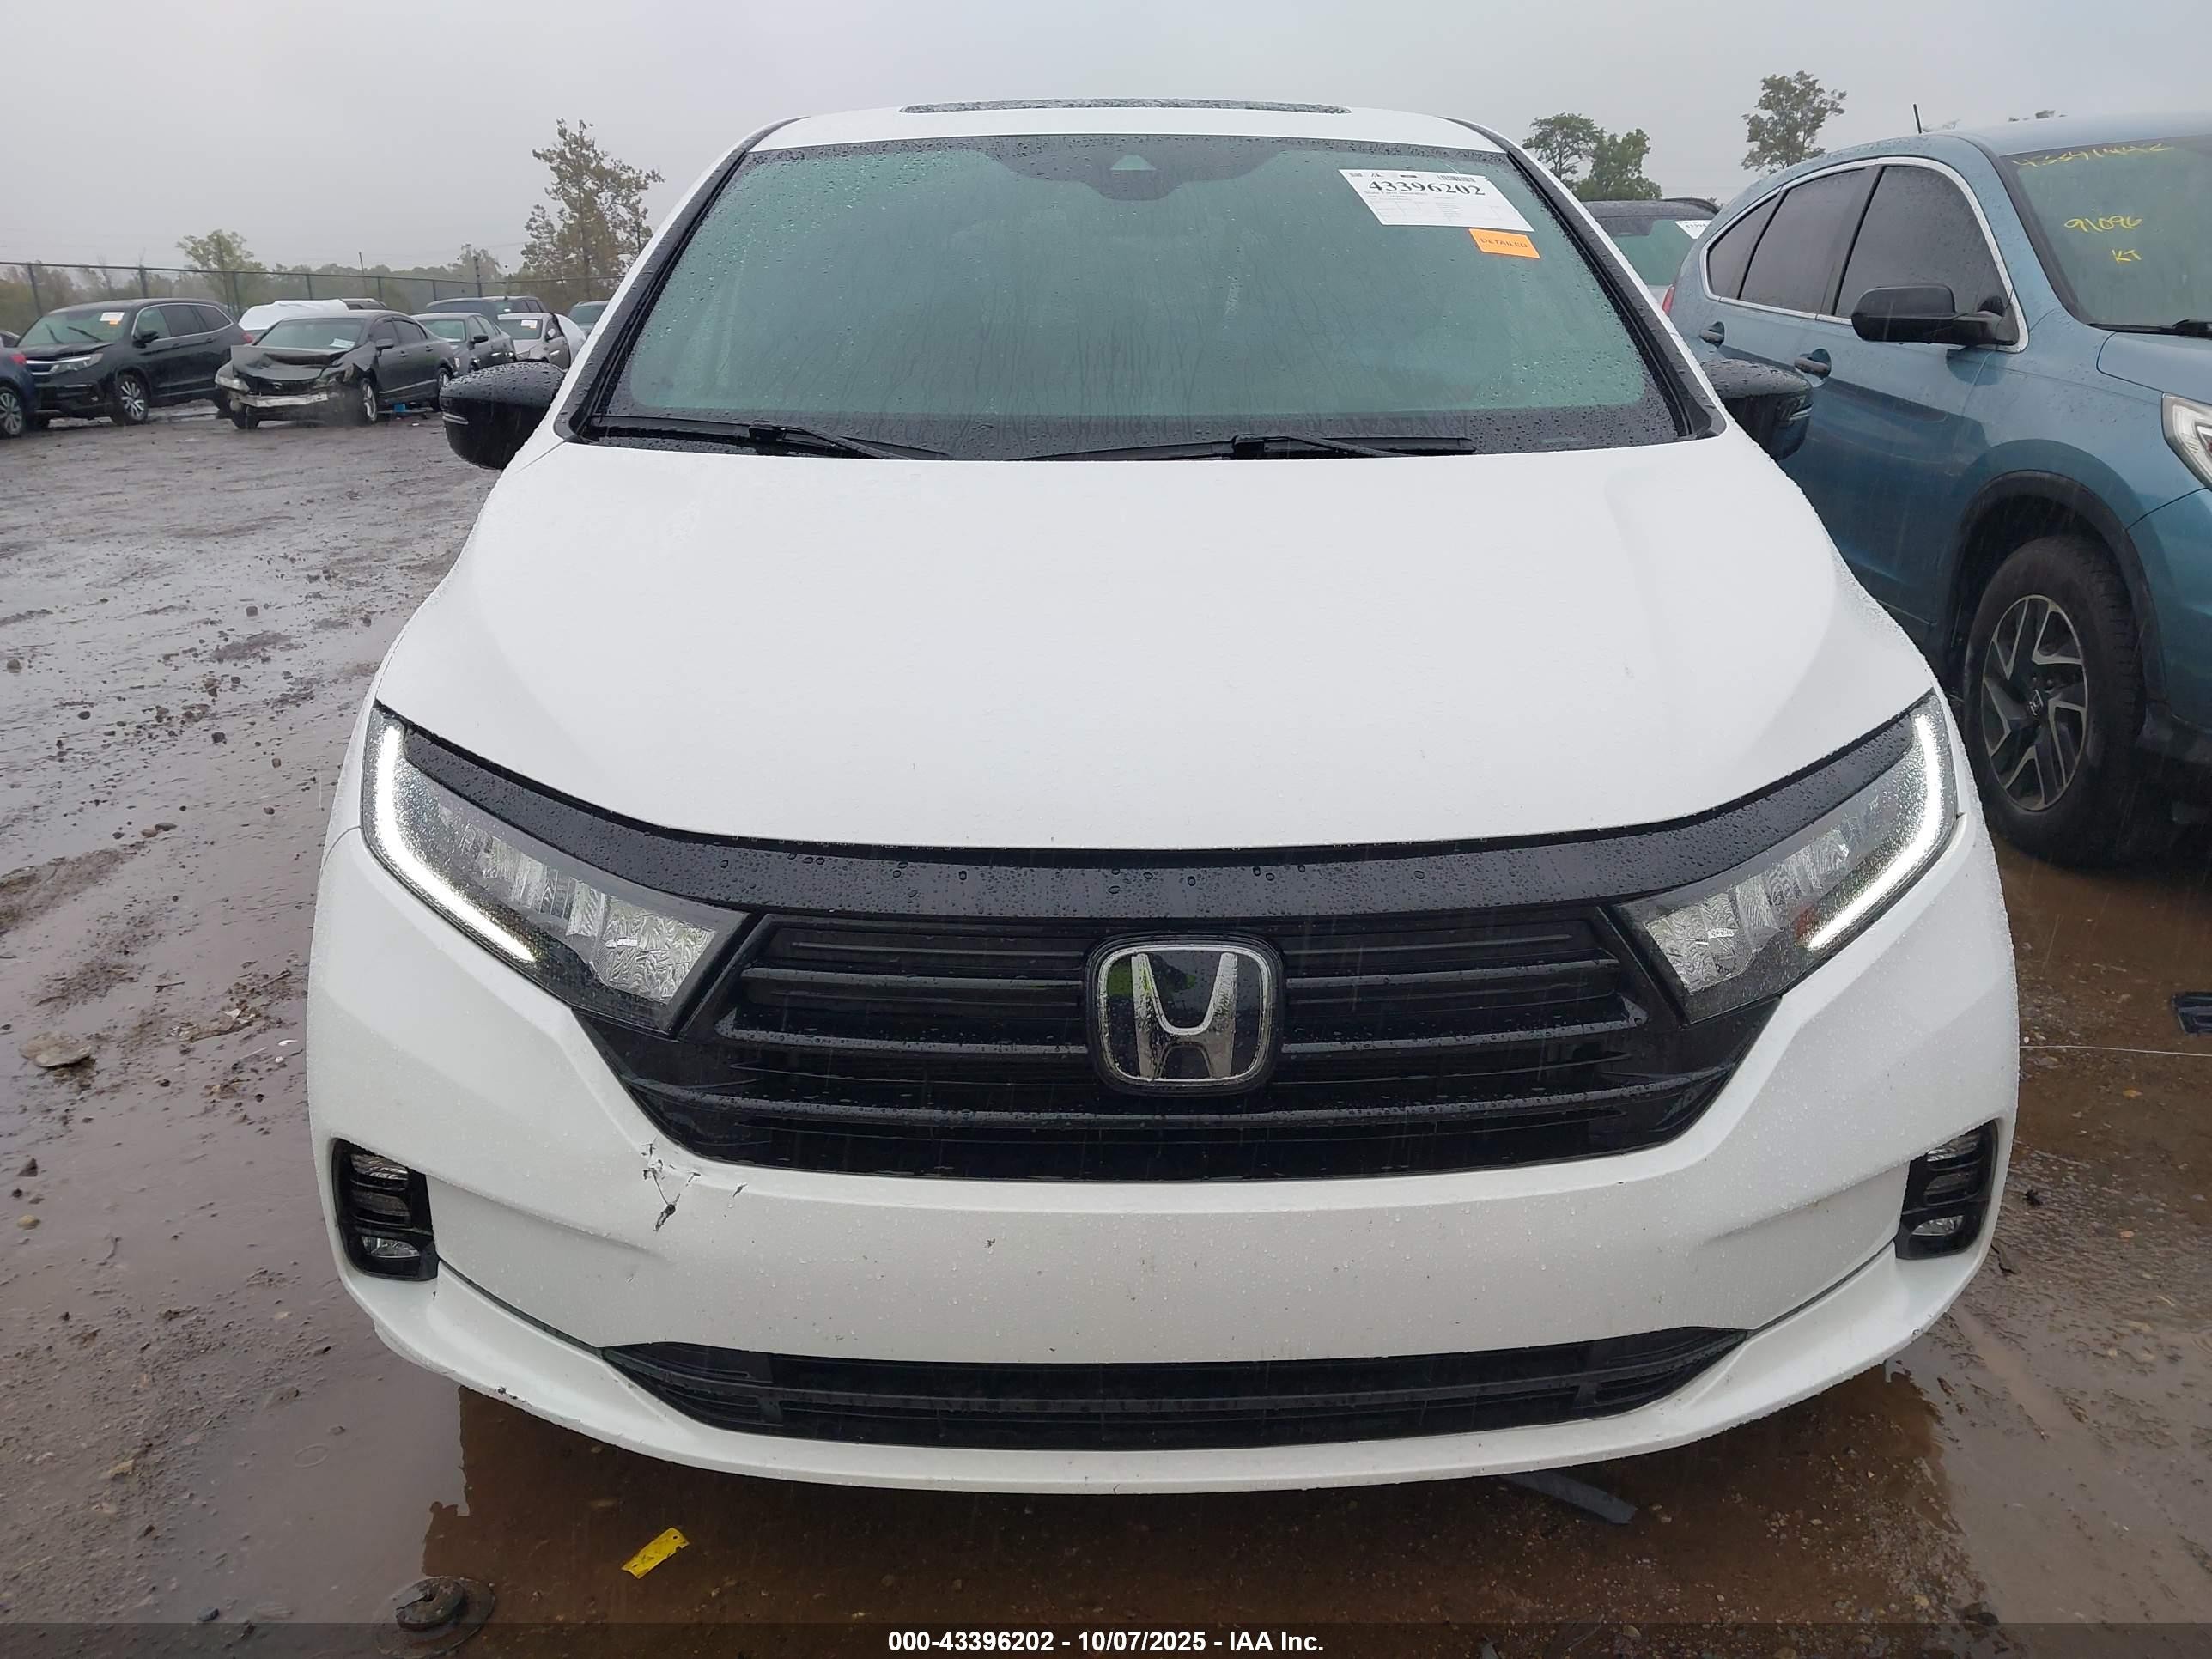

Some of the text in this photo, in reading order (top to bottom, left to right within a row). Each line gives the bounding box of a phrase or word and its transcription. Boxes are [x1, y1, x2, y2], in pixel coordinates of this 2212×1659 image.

[1369, 180, 1486, 197] 43396202
[2063, 216, 2143, 232] 91096
[1480, 238, 1528, 248] DETAILED
